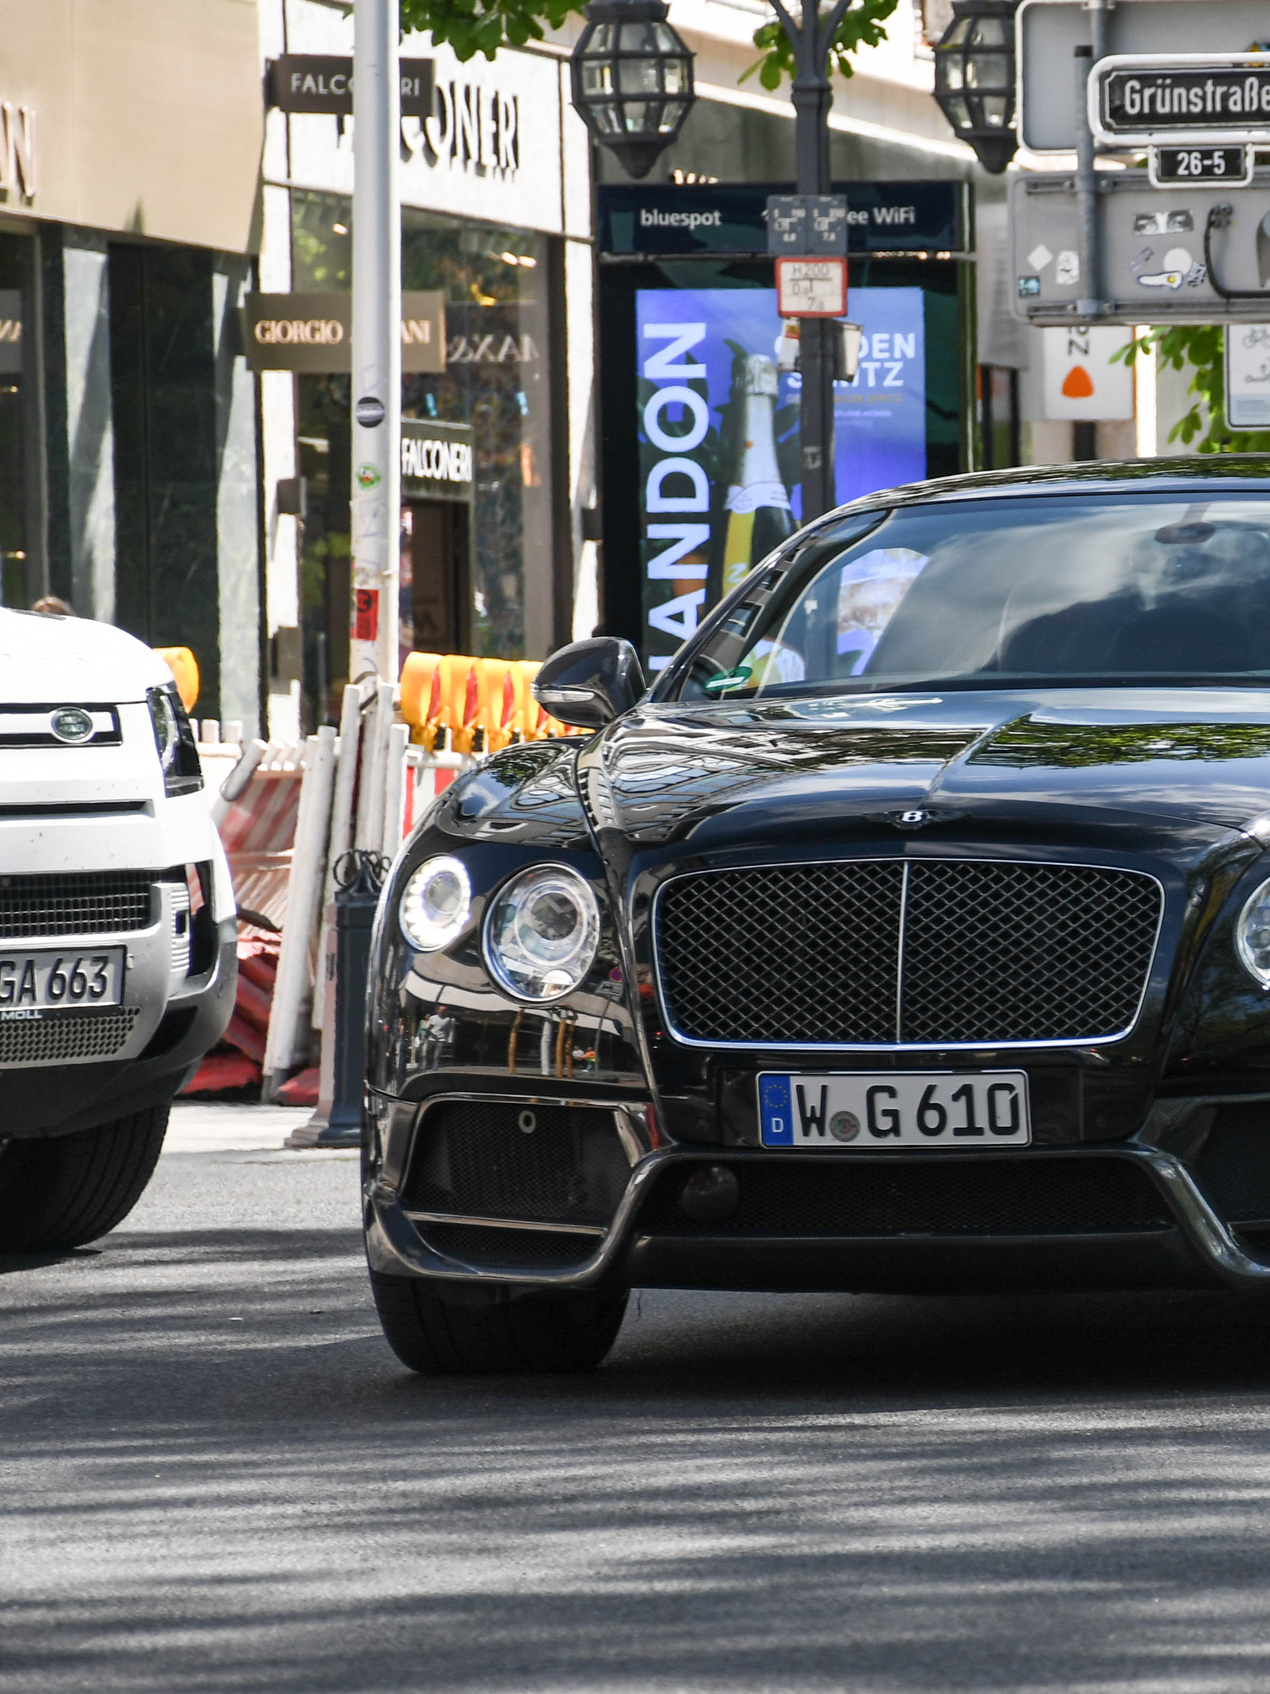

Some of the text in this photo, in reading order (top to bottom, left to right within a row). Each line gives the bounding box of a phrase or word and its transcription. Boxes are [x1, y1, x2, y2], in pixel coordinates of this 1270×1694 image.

[291, 73, 420, 97] FALCRI
[1177, 151, 1226, 176] 26-5
[640, 208, 722, 230] bluespot
[873, 206, 915, 224] WiFi
[254, 319, 343, 344] GIORGIO
[401, 437, 472, 483] FALCONERI
[901, 811, 923, 822] B
[0, 955, 109, 1003] GA 663
[1, 1011, 43, 1021] MOLL
[772, 1117, 784, 1133] D
[796, 1084, 828, 1137] W
[866, 1085, 901, 1138] G
[916, 1083, 1020, 1137] 610
